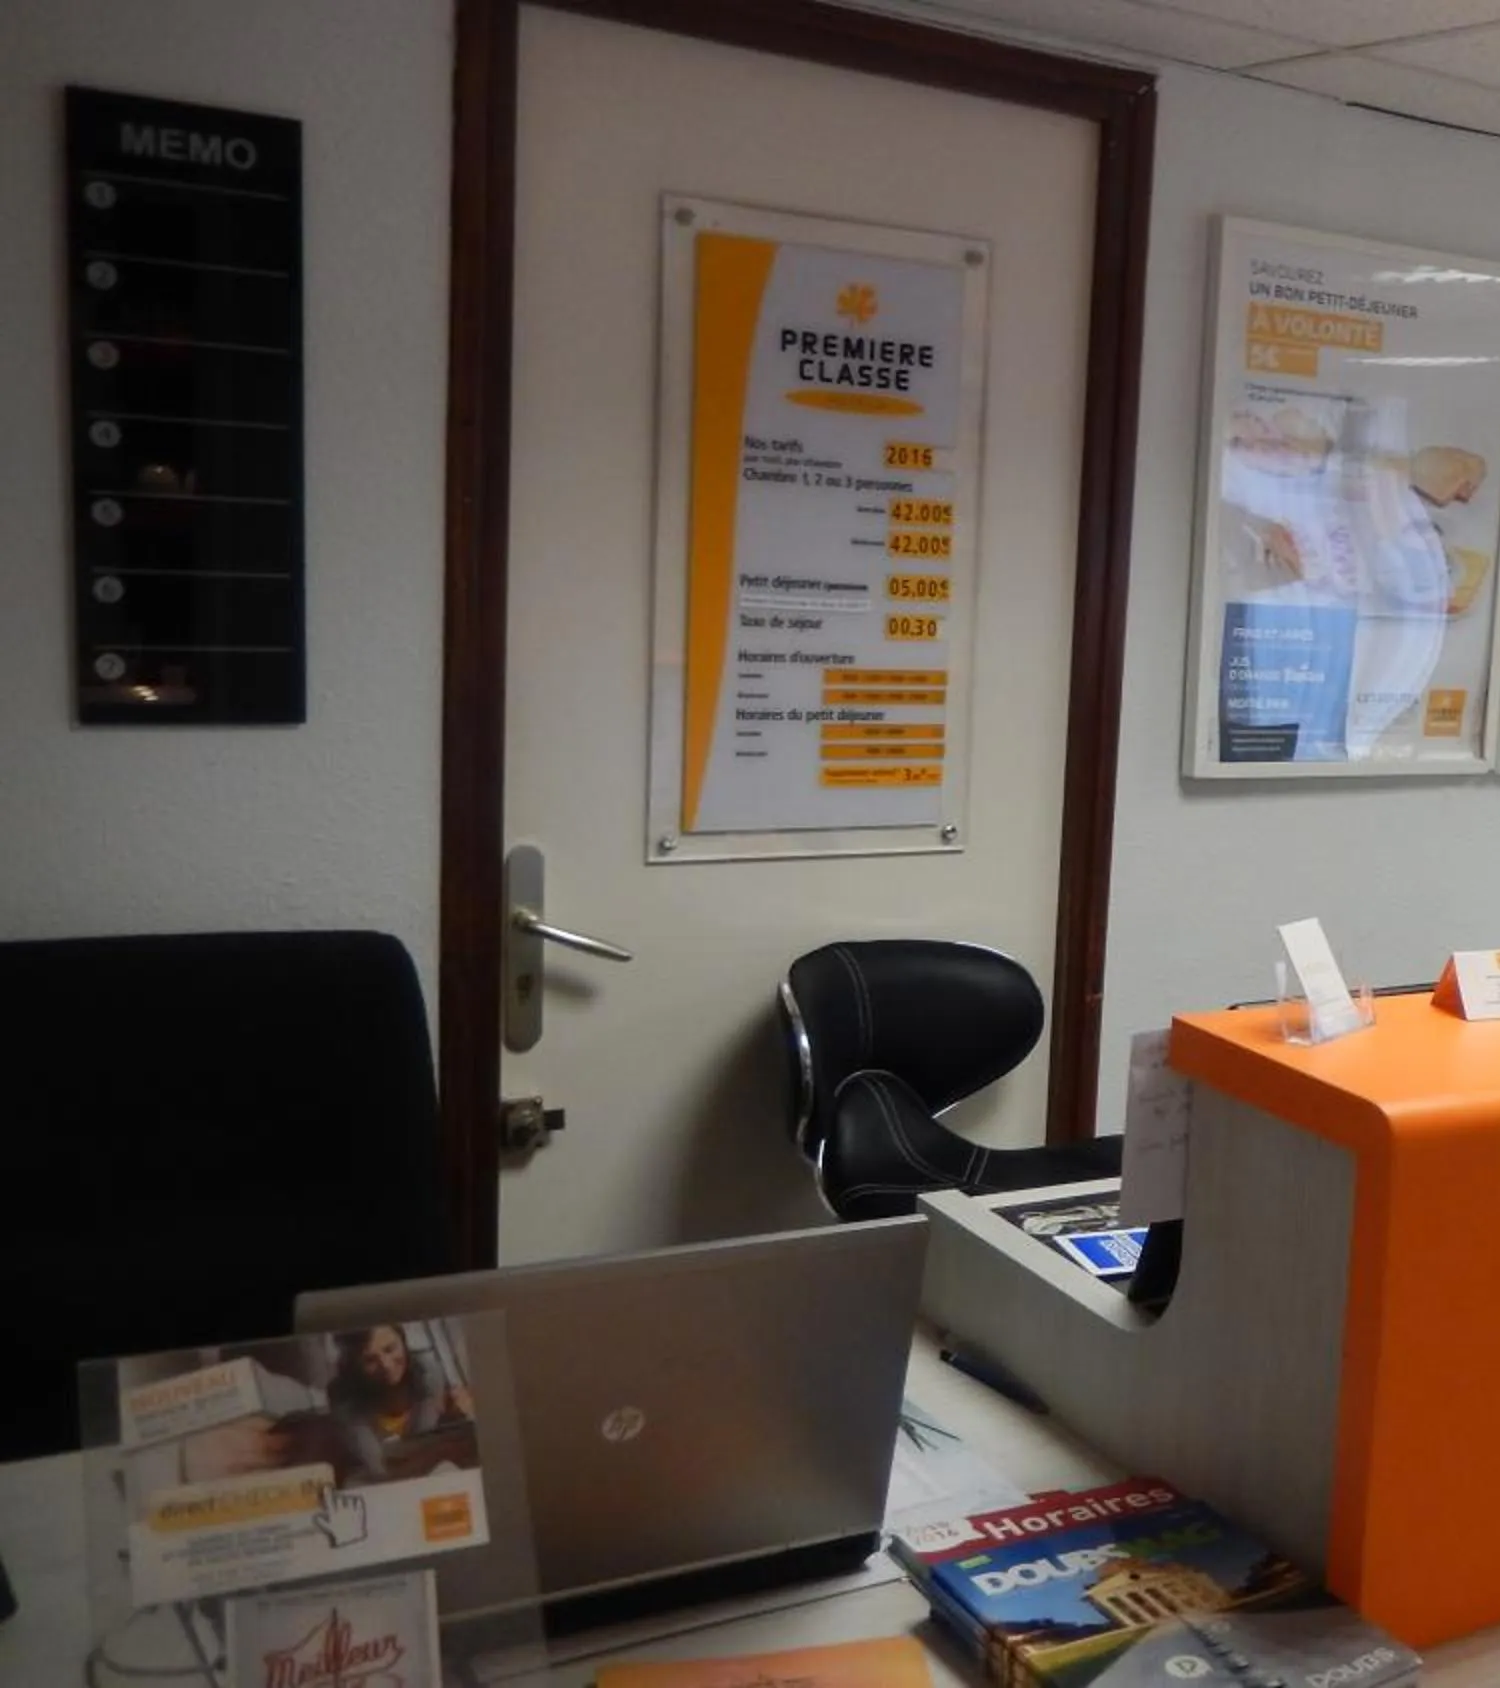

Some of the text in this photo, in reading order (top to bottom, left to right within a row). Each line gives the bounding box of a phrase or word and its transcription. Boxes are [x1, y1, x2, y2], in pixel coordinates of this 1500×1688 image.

[120, 122, 257, 170] MEMO
[1250, 258, 1325, 285] SAVOUREZ
[1249, 281, 1418, 320] UN BON PETIT-DÉJEUNER
[780, 328, 934, 368] PREMIERE
[799, 359, 911, 391] CLASSE
[744, 435, 804, 453] Nos tarifs
[886, 446, 933, 466] 2016
[743, 467, 798, 484] Chambre
[815, 473, 824, 486] 2
[845, 475, 853, 490] 3
[855, 478, 914, 493] personnes
[740, 573, 769, 588] Petit
[771, 575, 822, 592] déjeuner
[769, 614, 784, 628] de
[888, 617, 938, 637] 00.30
[738, 649, 855, 666] Horaires d'ouverture
[736, 708, 886, 728] Horaires du petit déjeuner
[604, 1405, 644, 1443] hp
[982, 1486, 1175, 1540] Horaires
[1304, 1646, 1397, 1688] DOUBS
